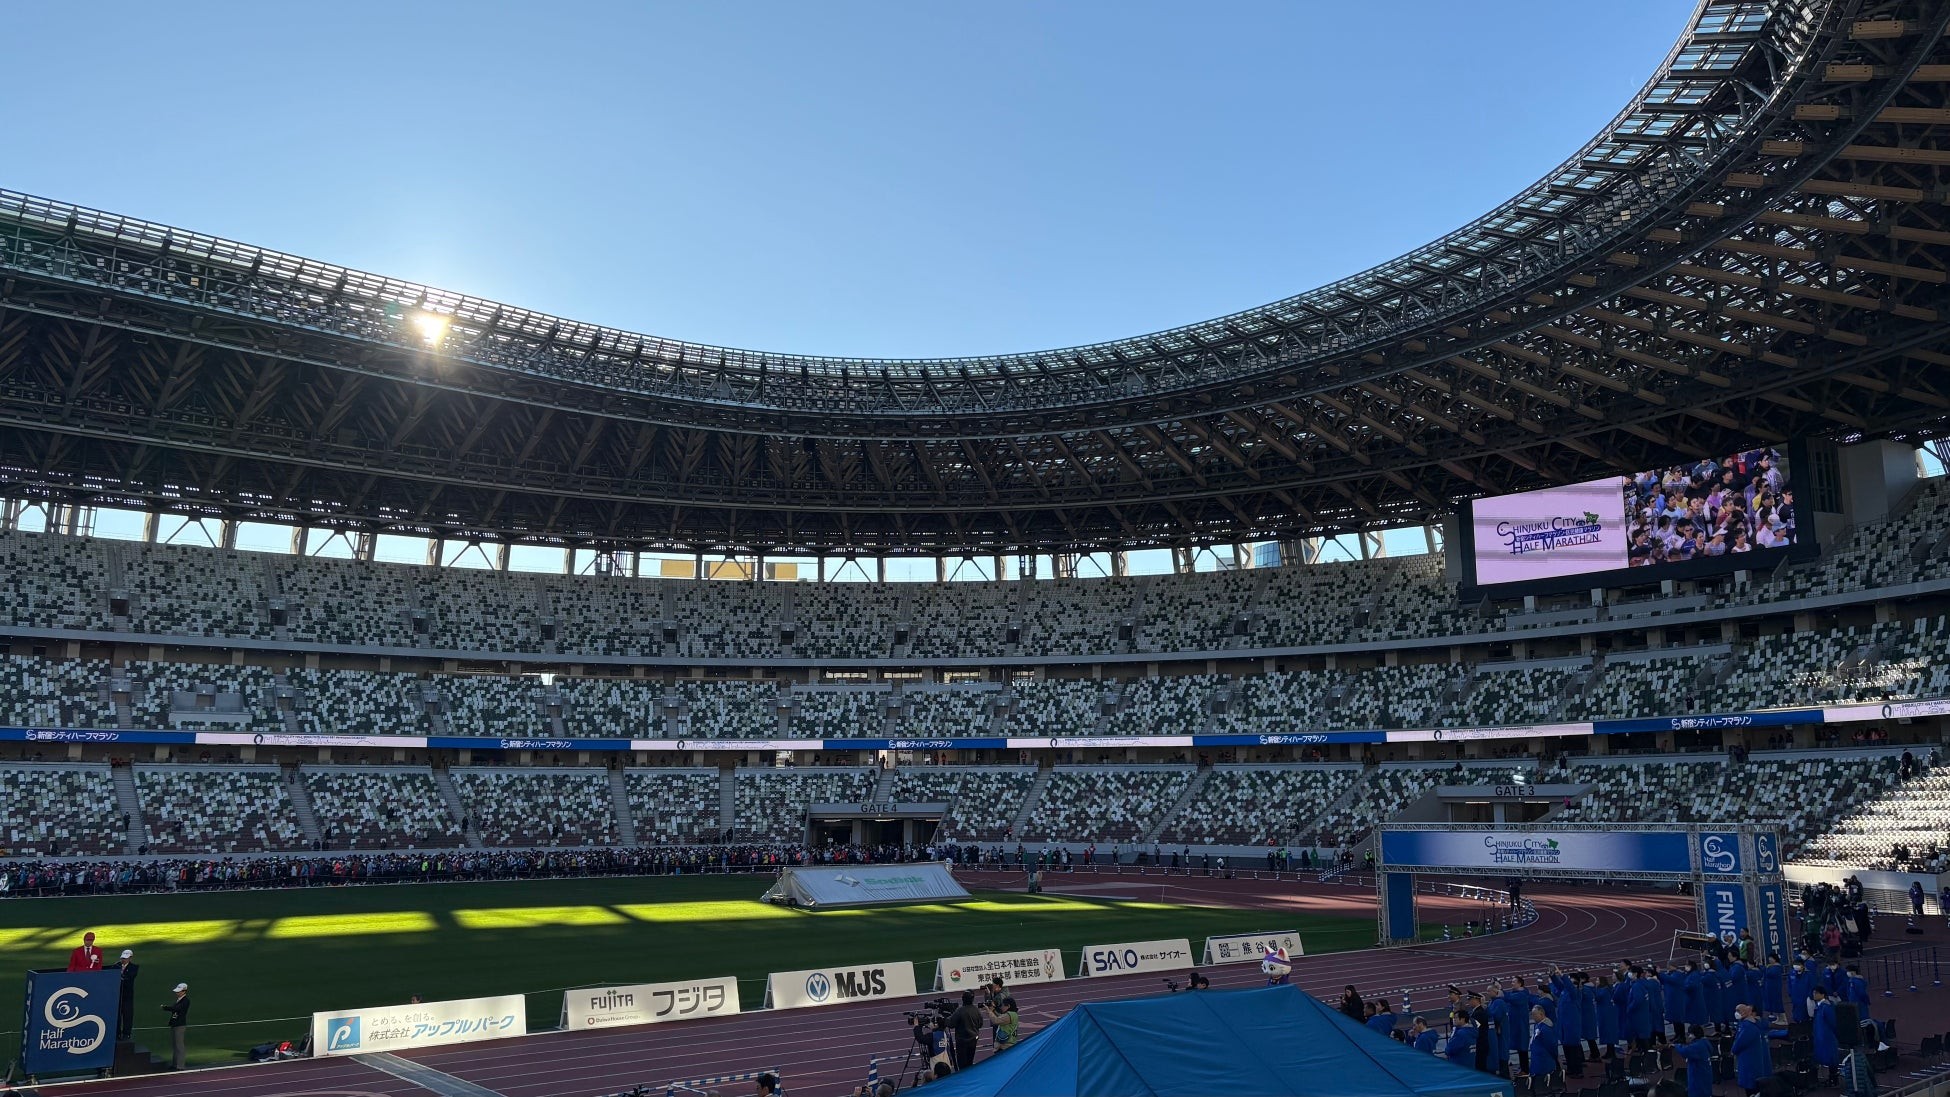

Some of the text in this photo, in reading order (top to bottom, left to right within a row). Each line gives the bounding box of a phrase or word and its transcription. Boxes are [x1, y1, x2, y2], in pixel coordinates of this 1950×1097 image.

[1497, 517, 1577, 546] SHINJUKU CITY
[1513, 533, 1599, 555] HALF MARATHON
[1496, 786, 1534, 795] GATE 3
[861, 804, 897, 812] GATE 4
[1485, 836, 1522, 855] SHINJUKU
[1524, 839, 1542, 849] CITY
[1496, 854, 1515, 863] HALF
[1517, 852, 1559, 863] MARATHON
[1705, 861, 1731, 869] Marathon
[1716, 890, 1737, 948] FINIS
[1159, 950, 1187, 959] サイオー
[987, 958, 1039, 970] 全日本不動産協会
[1014, 969, 1040, 979] 新宿支部
[835, 969, 886, 998] MJS
[652, 985, 725, 1016] フジタ
[372, 1013, 435, 1027] とめる、を創る。
[40, 1028, 64, 1040] Half
[368, 1015, 515, 1041] 株式会社 アップルパーク
[40, 1037, 95, 1051] Marathon
